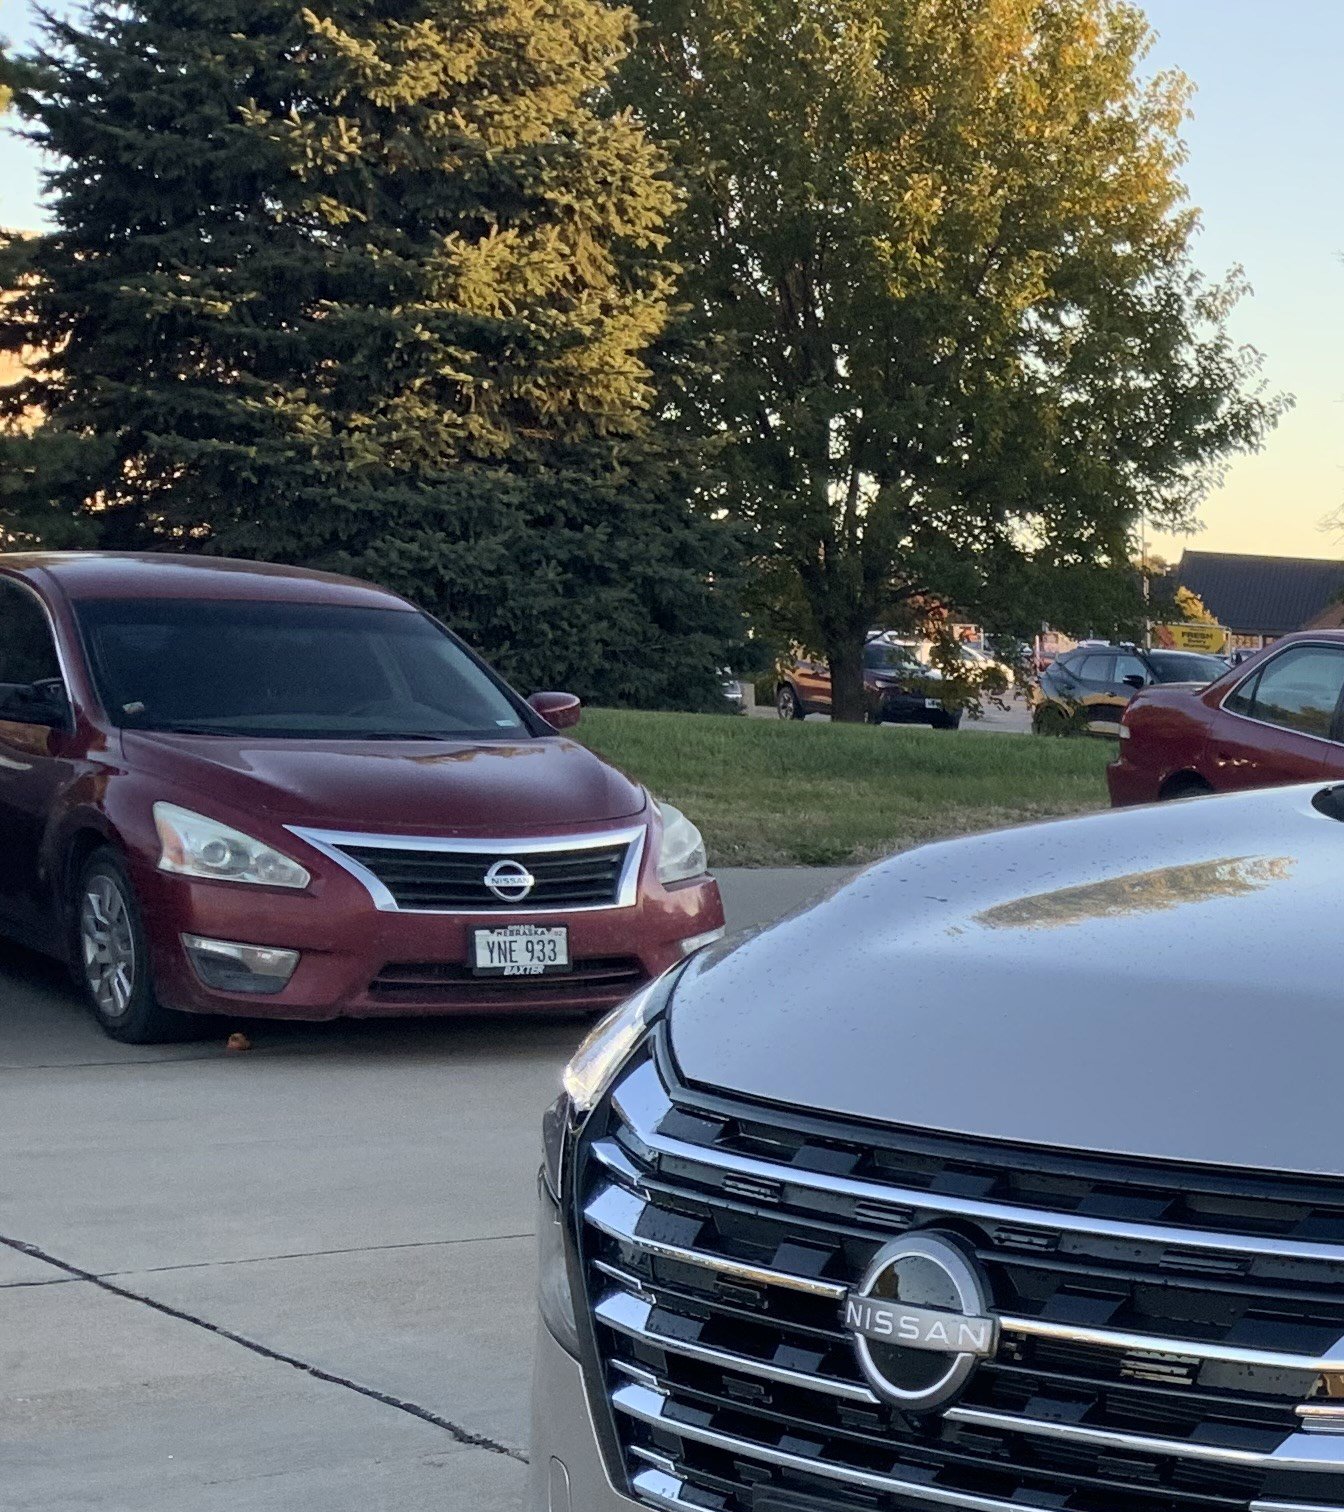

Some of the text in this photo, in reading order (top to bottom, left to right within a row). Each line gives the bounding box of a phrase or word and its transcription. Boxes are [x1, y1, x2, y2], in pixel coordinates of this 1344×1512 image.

[491, 877, 530, 885] NISSAN
[487, 939, 557, 964] YNE 933
[504, 965, 545, 976] BAXTER
[846, 1300, 985, 1349] NISSAN
